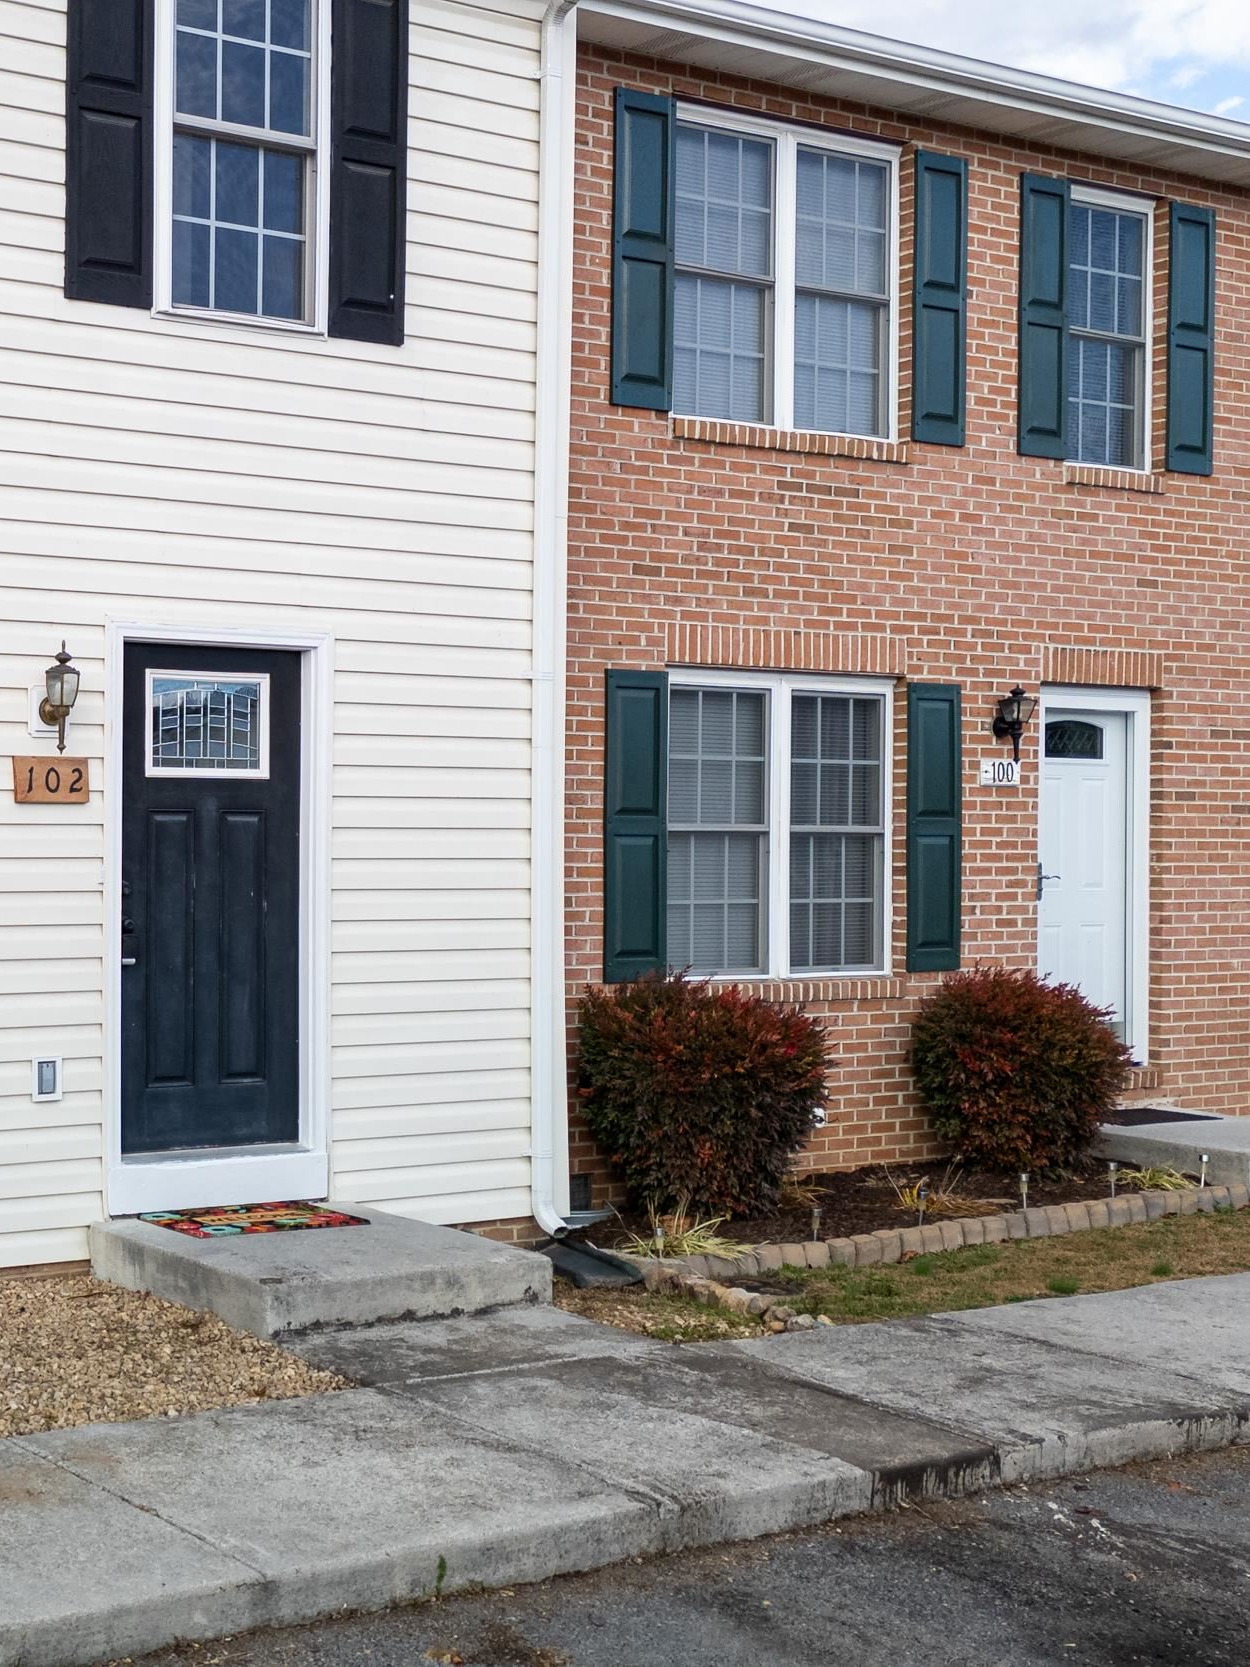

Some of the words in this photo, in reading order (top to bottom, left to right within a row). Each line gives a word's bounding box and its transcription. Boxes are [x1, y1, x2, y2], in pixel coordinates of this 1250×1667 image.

[26, 766, 83, 793] 102
[991, 761, 1014, 783] 100
[202, 1212, 307, 1223] WELCOME
